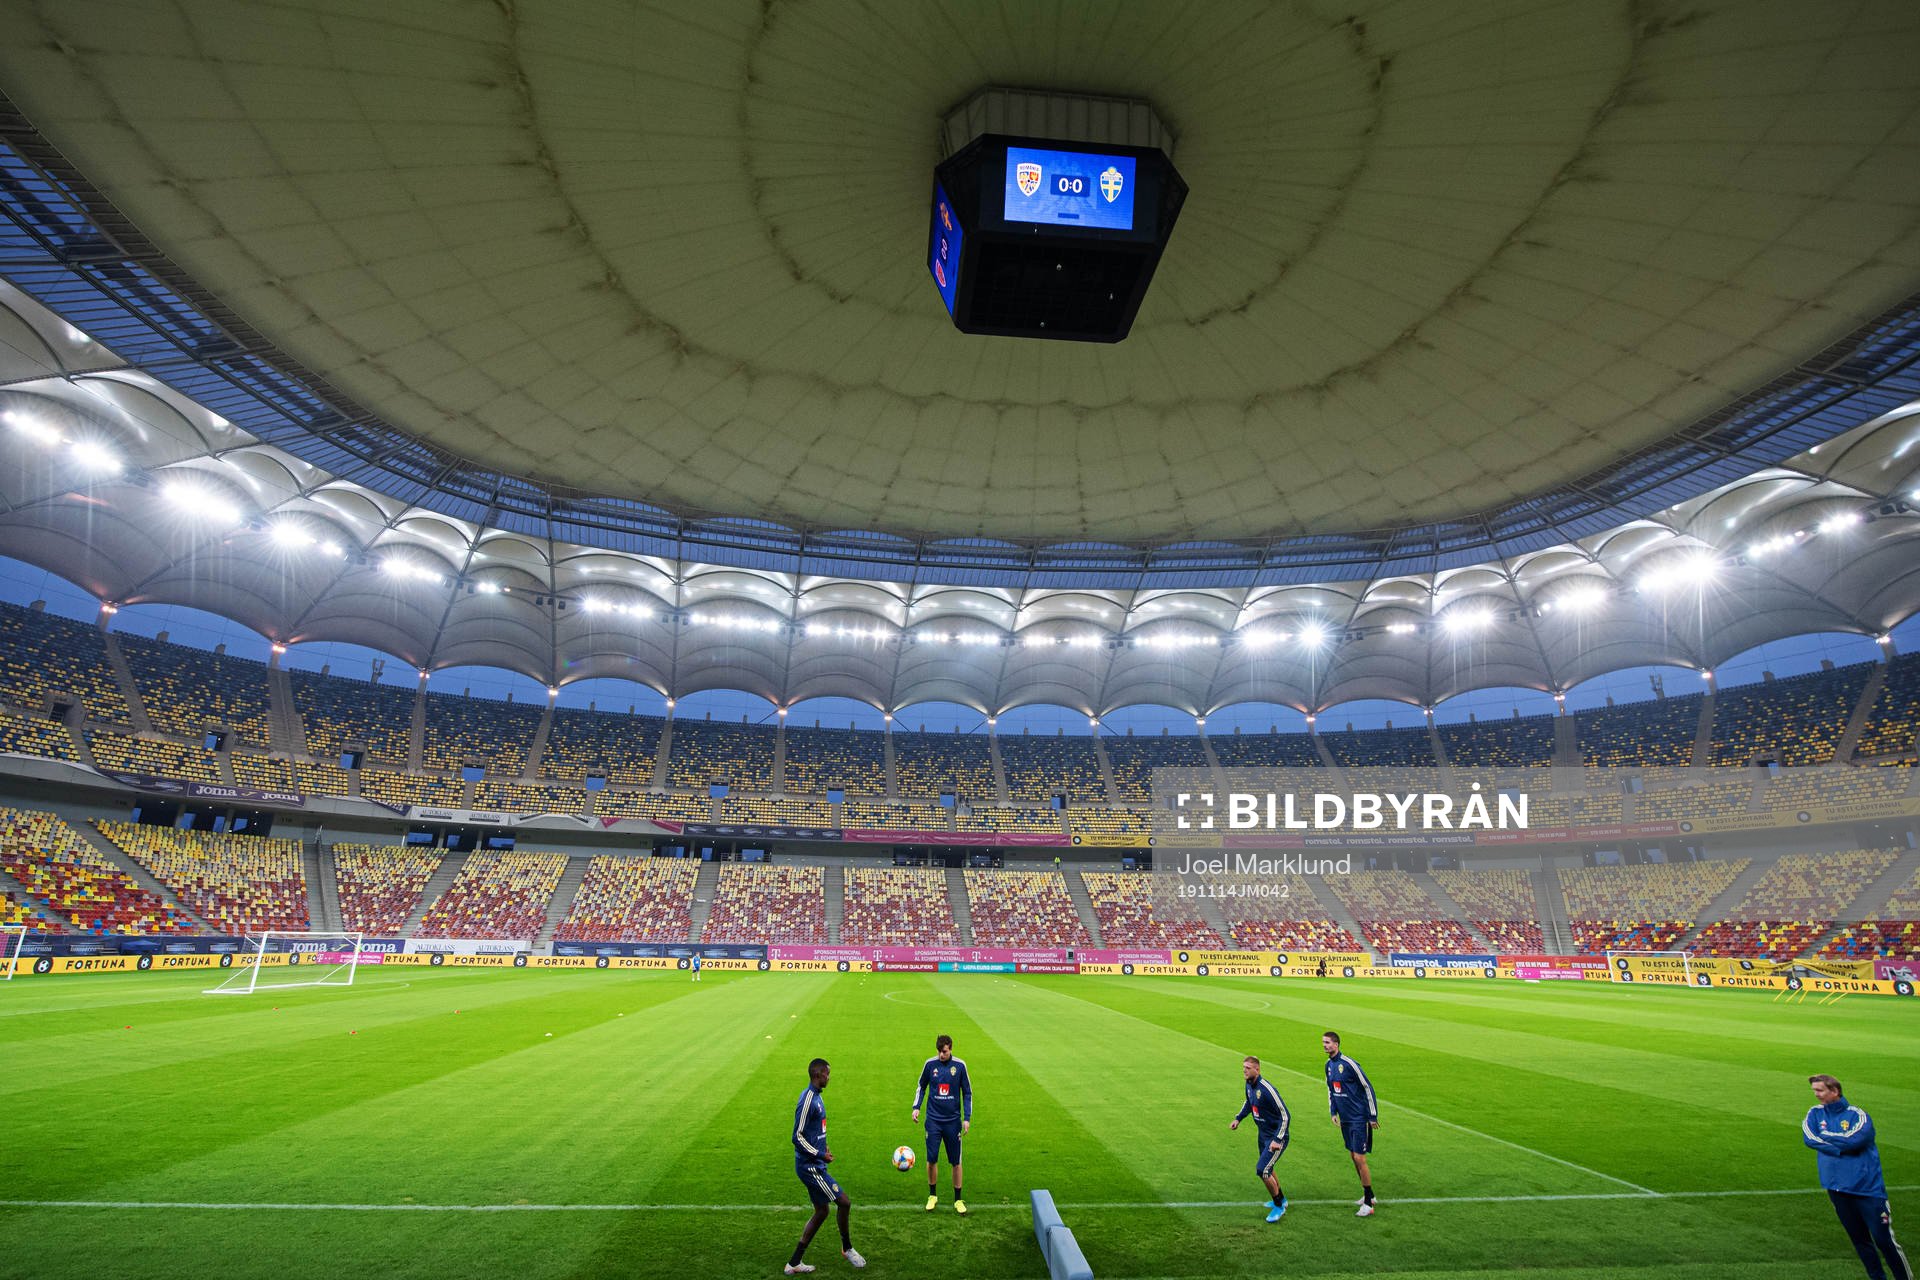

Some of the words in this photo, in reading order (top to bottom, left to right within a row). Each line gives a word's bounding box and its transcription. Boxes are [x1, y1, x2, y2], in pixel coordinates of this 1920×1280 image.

[1058, 177, 1083, 193] 0:0
[163, 957, 211, 966] FORTUNA
[384, 955, 420, 963] RTUNA
[454, 957, 504, 965] FORTUNA
[537, 958, 586, 966] FORTUNA
[619, 959, 668, 967] FORTUNA
[65, 959, 126, 970] FORTUNA
[700, 961, 748, 969] FORTUNA
[1143, 966, 1188, 974] FORTUNA
[1218, 967, 1262, 975] FORTUNA
[1585, 971, 1612, 979] RTUNA
[1641, 973, 1688, 983] FORTUNA
[1721, 977, 1775, 987] FORTUNA
[1815, 980, 1880, 992] FORTUNA
